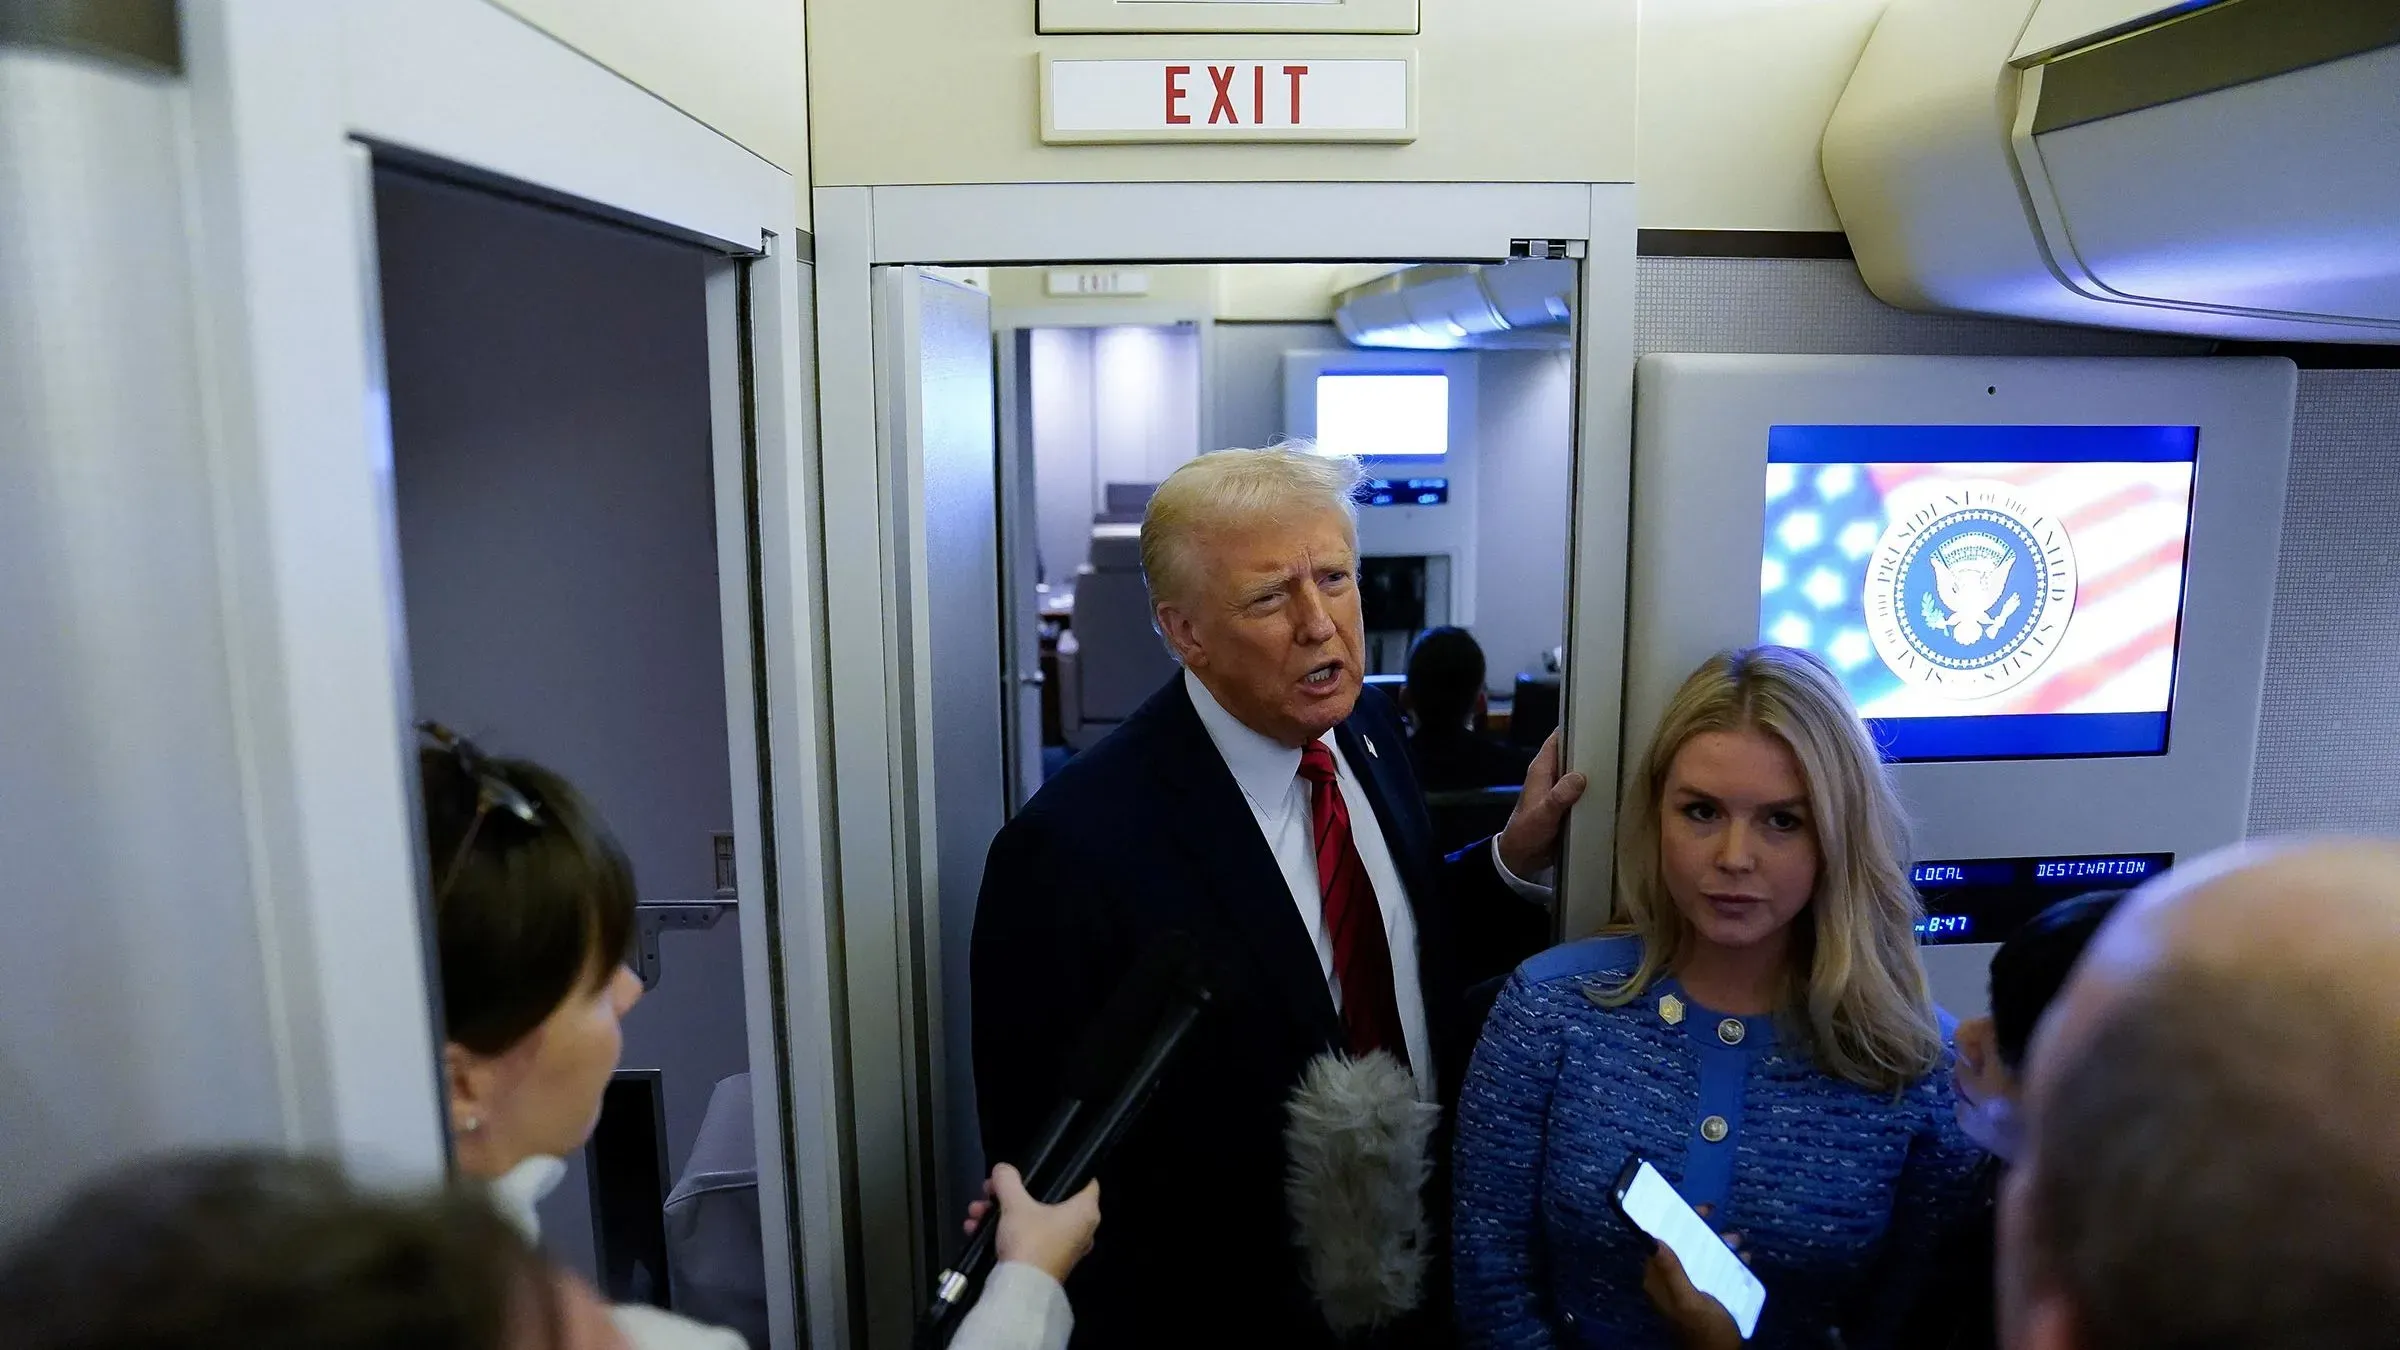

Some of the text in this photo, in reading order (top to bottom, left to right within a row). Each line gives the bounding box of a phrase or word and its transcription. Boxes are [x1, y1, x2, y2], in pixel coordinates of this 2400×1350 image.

[1165, 65, 1308, 125] EXIT
[1915, 867, 1963, 881] LOCAL
[2036, 861, 2146, 878] DESTINATION
[1928, 916, 1967, 932] 8:47
